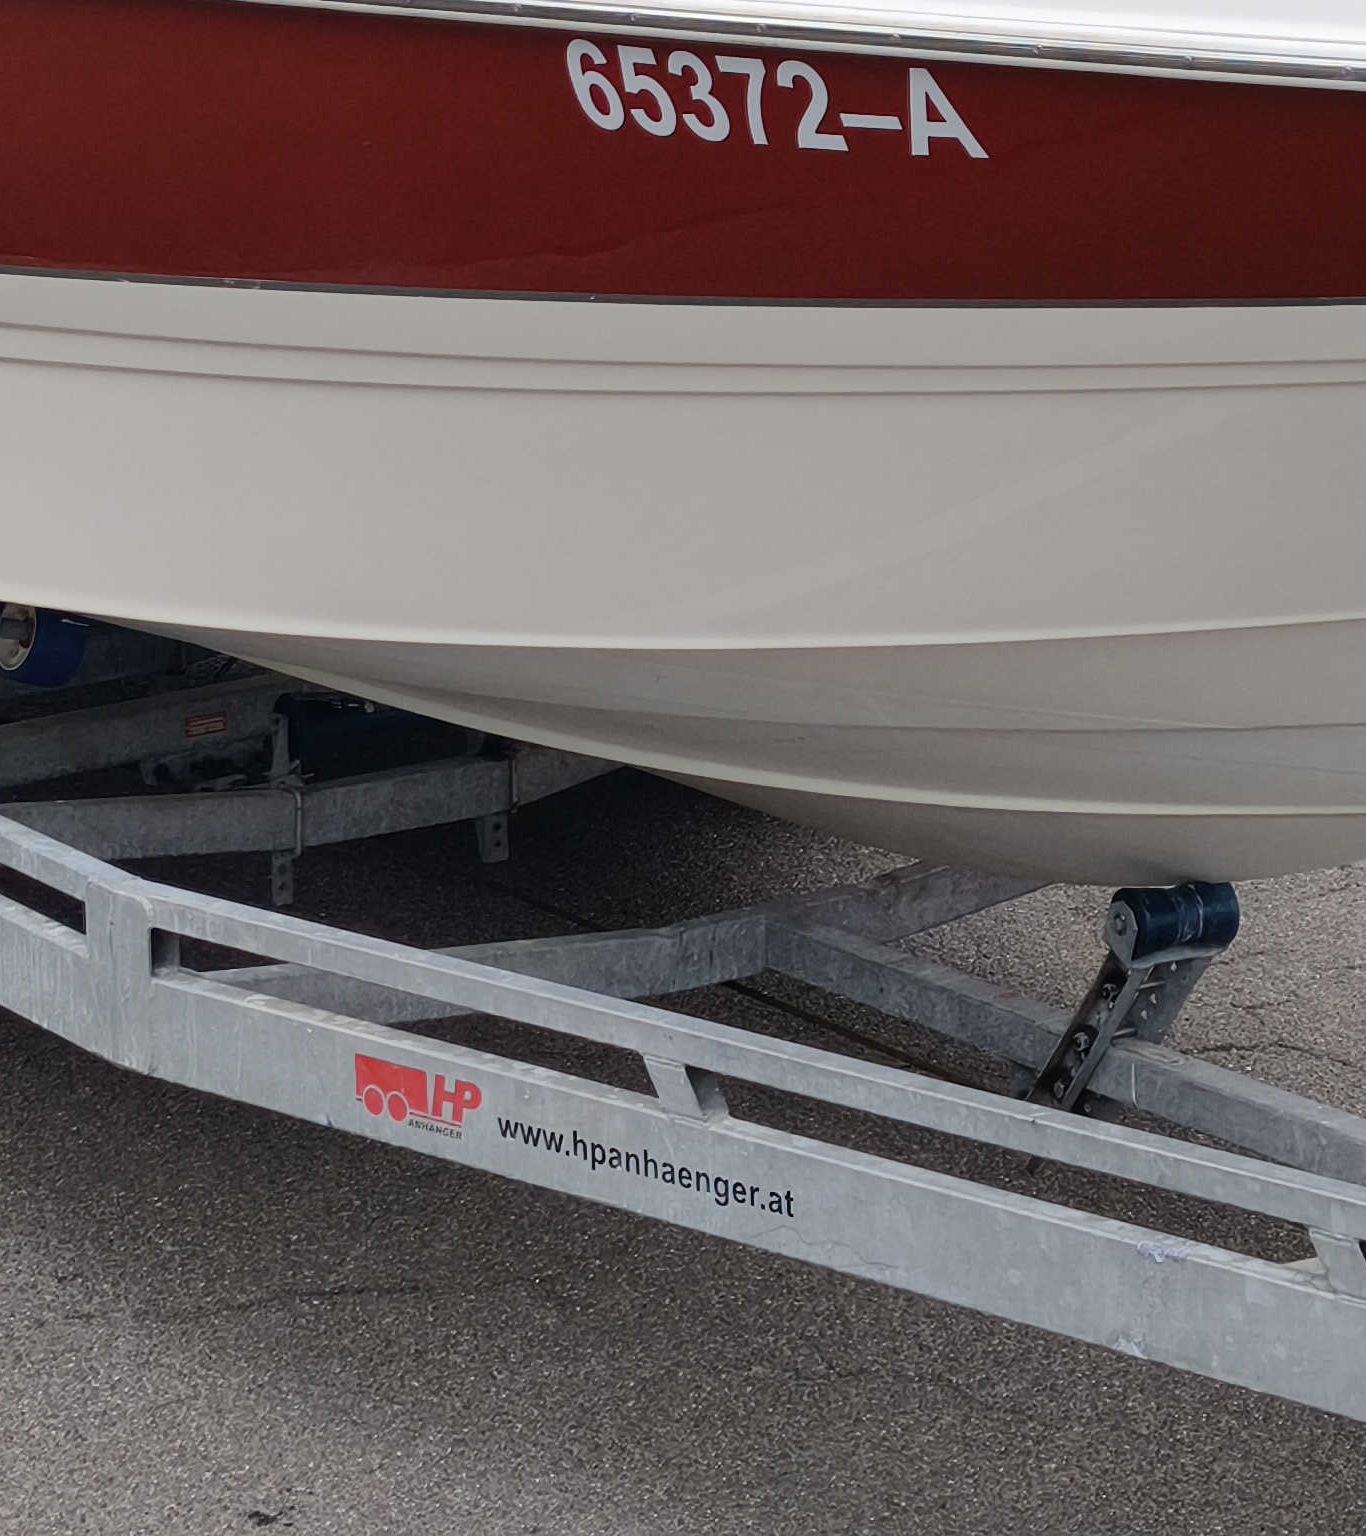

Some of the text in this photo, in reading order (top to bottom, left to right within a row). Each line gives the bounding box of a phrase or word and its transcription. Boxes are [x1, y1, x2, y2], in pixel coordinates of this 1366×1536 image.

[565, 38, 990, 159] 65372-A
[431, 1073, 482, 1124] HP
[497, 1116, 795, 1219] www.hpanhaenger.at
